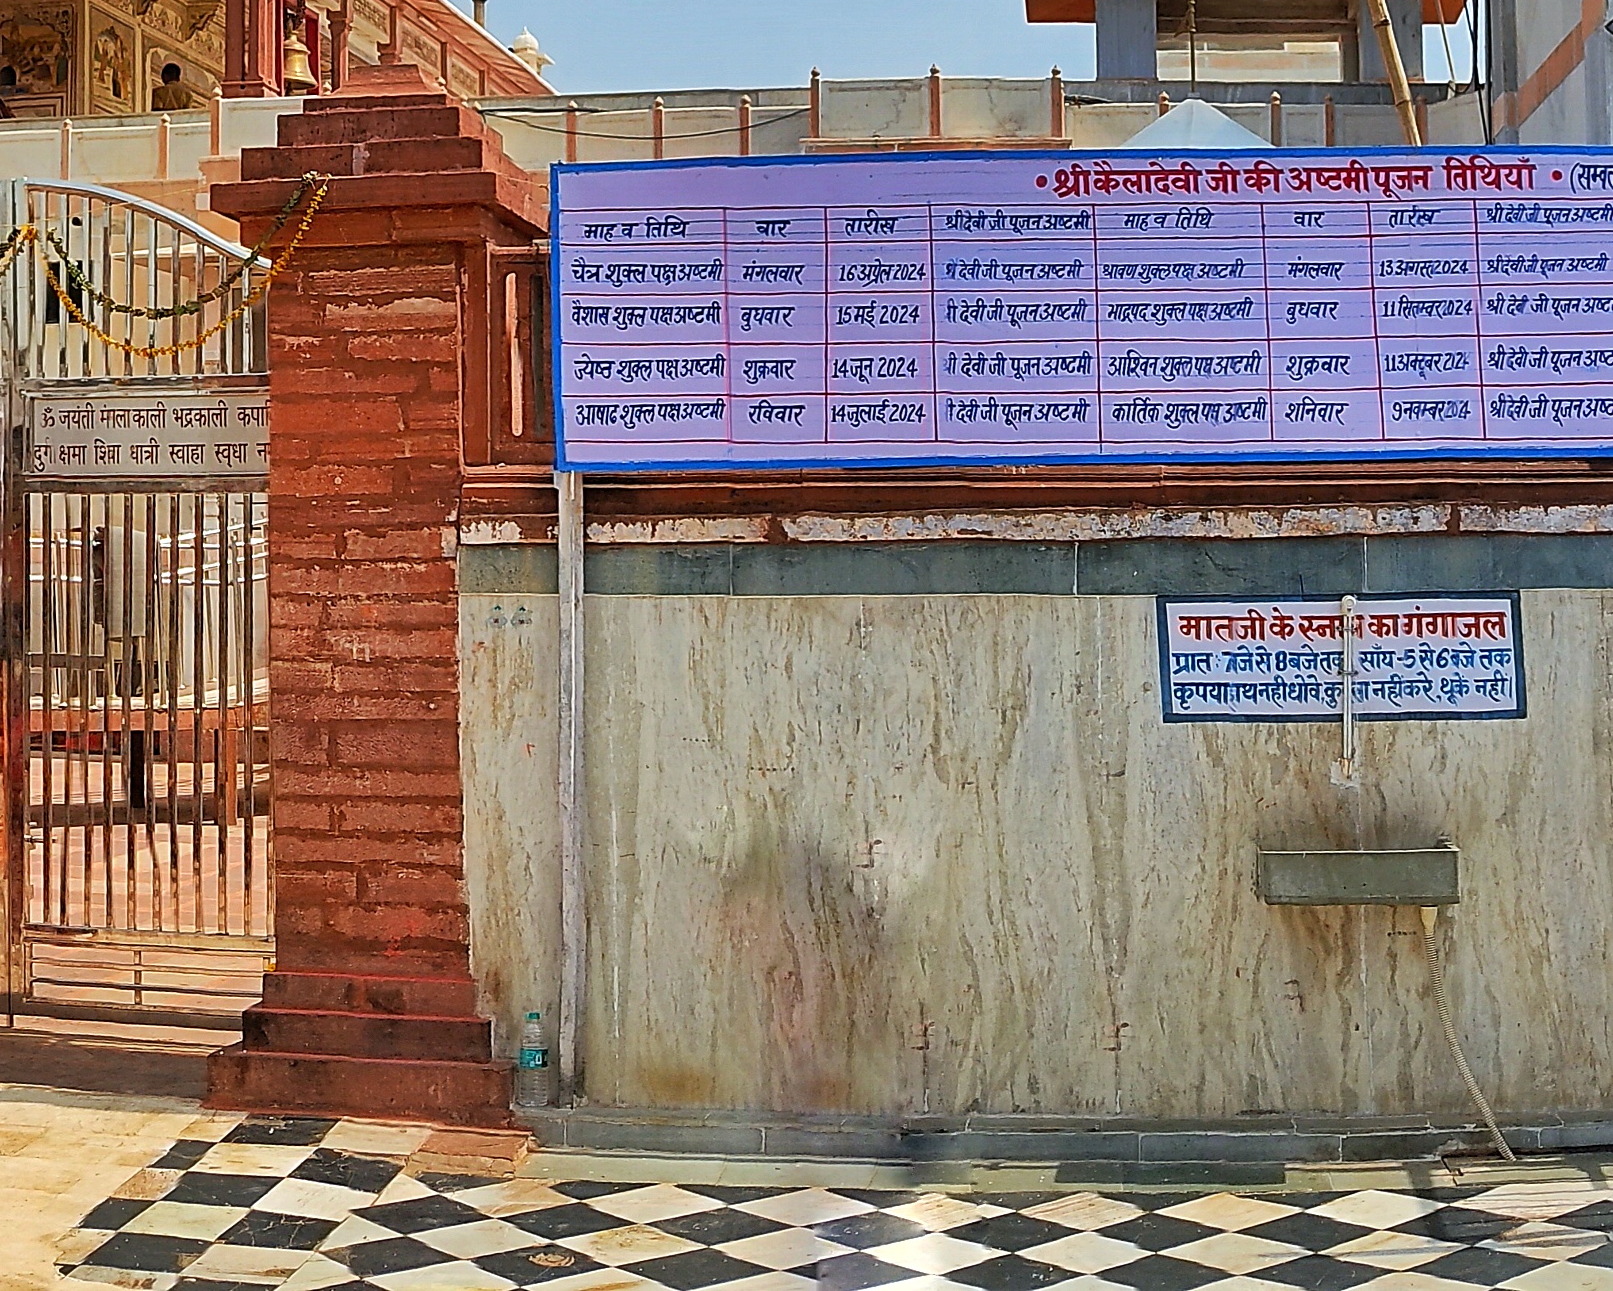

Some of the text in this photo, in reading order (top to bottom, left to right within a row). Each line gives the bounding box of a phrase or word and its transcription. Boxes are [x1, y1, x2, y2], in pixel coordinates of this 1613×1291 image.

[1053, 162, 1091, 198] श्री
[1205, 162, 1241, 194] जी
[1243, 160, 1285, 194] की
[1285, 159, 1370, 194] अष्टमी
[1372, 165, 1434, 201] पूजन
[584, 215, 689, 242] माह व तिथि
[755, 219, 792, 238] वार
[844, 209, 900, 236] तारीख
[1293, 211, 1325, 228] वार
[676, 257, 724, 283] अष्टमी
[741, 258, 806, 286] मंगलवार
[1287, 255, 1345, 281] मंगलवार
[674, 300, 722, 326] अष्टमी
[680, 353, 726, 378] अष्टमी
[743, 359, 797, 385] शुक्रवार
[1286, 354, 1351, 381] शुक्रवार
[58, 400, 229, 430] जयंती काली भद्रकाली
[681, 398, 726, 421] अष्टमी
[748, 399, 807, 426] रविवार
[1284, 396, 1350, 426] शनिवार
[58, 444, 88, 466] क्षमा
[129, 437, 161, 466] धात्री
[168, 444, 206, 466] स्वाहा
[1269, 606, 1295, 641] के
[1368, 614, 1400, 639] का
[1401, 605, 1507, 641] गंगाजल
[1478, 647, 1513, 671] तक
